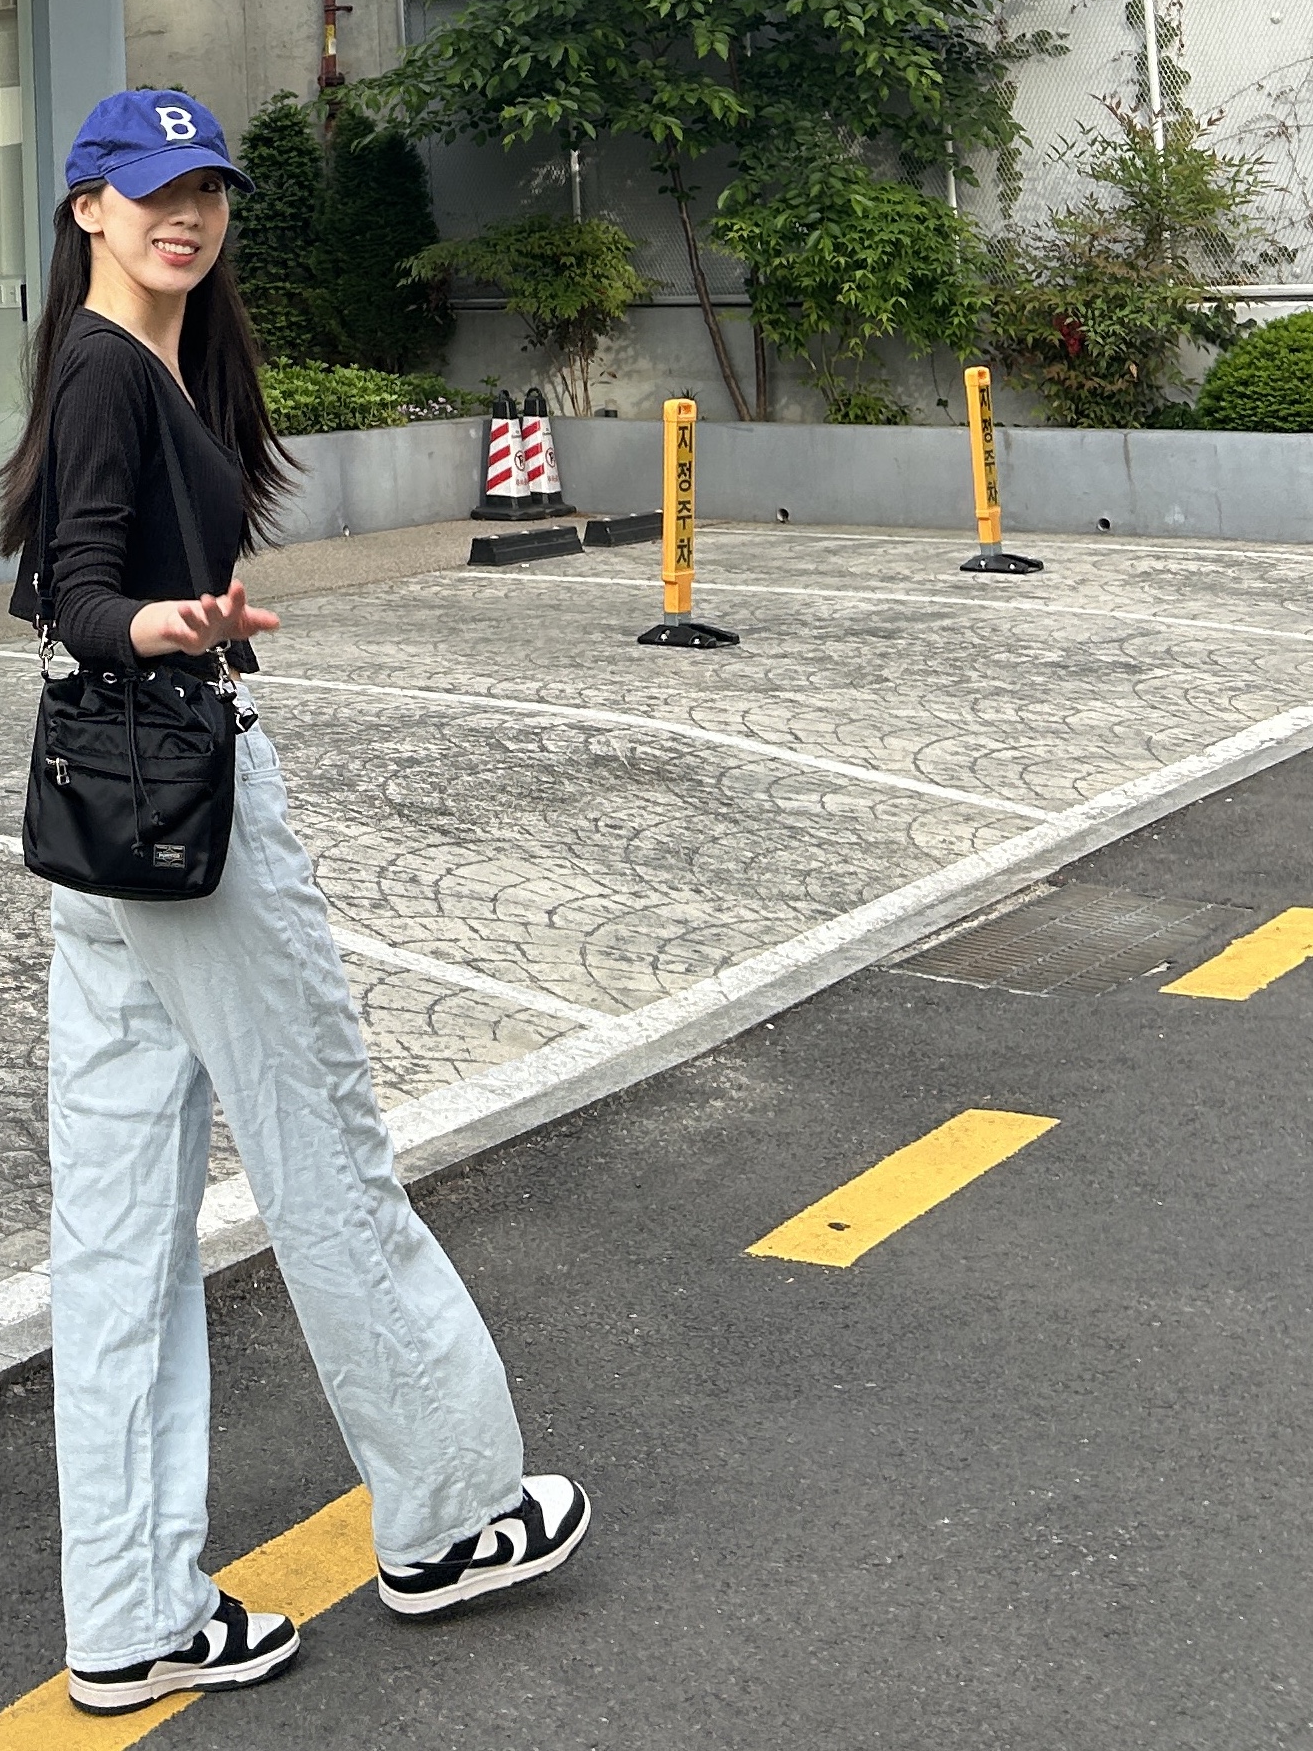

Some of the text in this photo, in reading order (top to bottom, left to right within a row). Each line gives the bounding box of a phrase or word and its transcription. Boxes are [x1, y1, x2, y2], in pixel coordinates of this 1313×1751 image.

[155, 106, 197, 141] B
[676, 423, 693, 569] 지정주차
[979, 385, 998, 506] 지정주차
